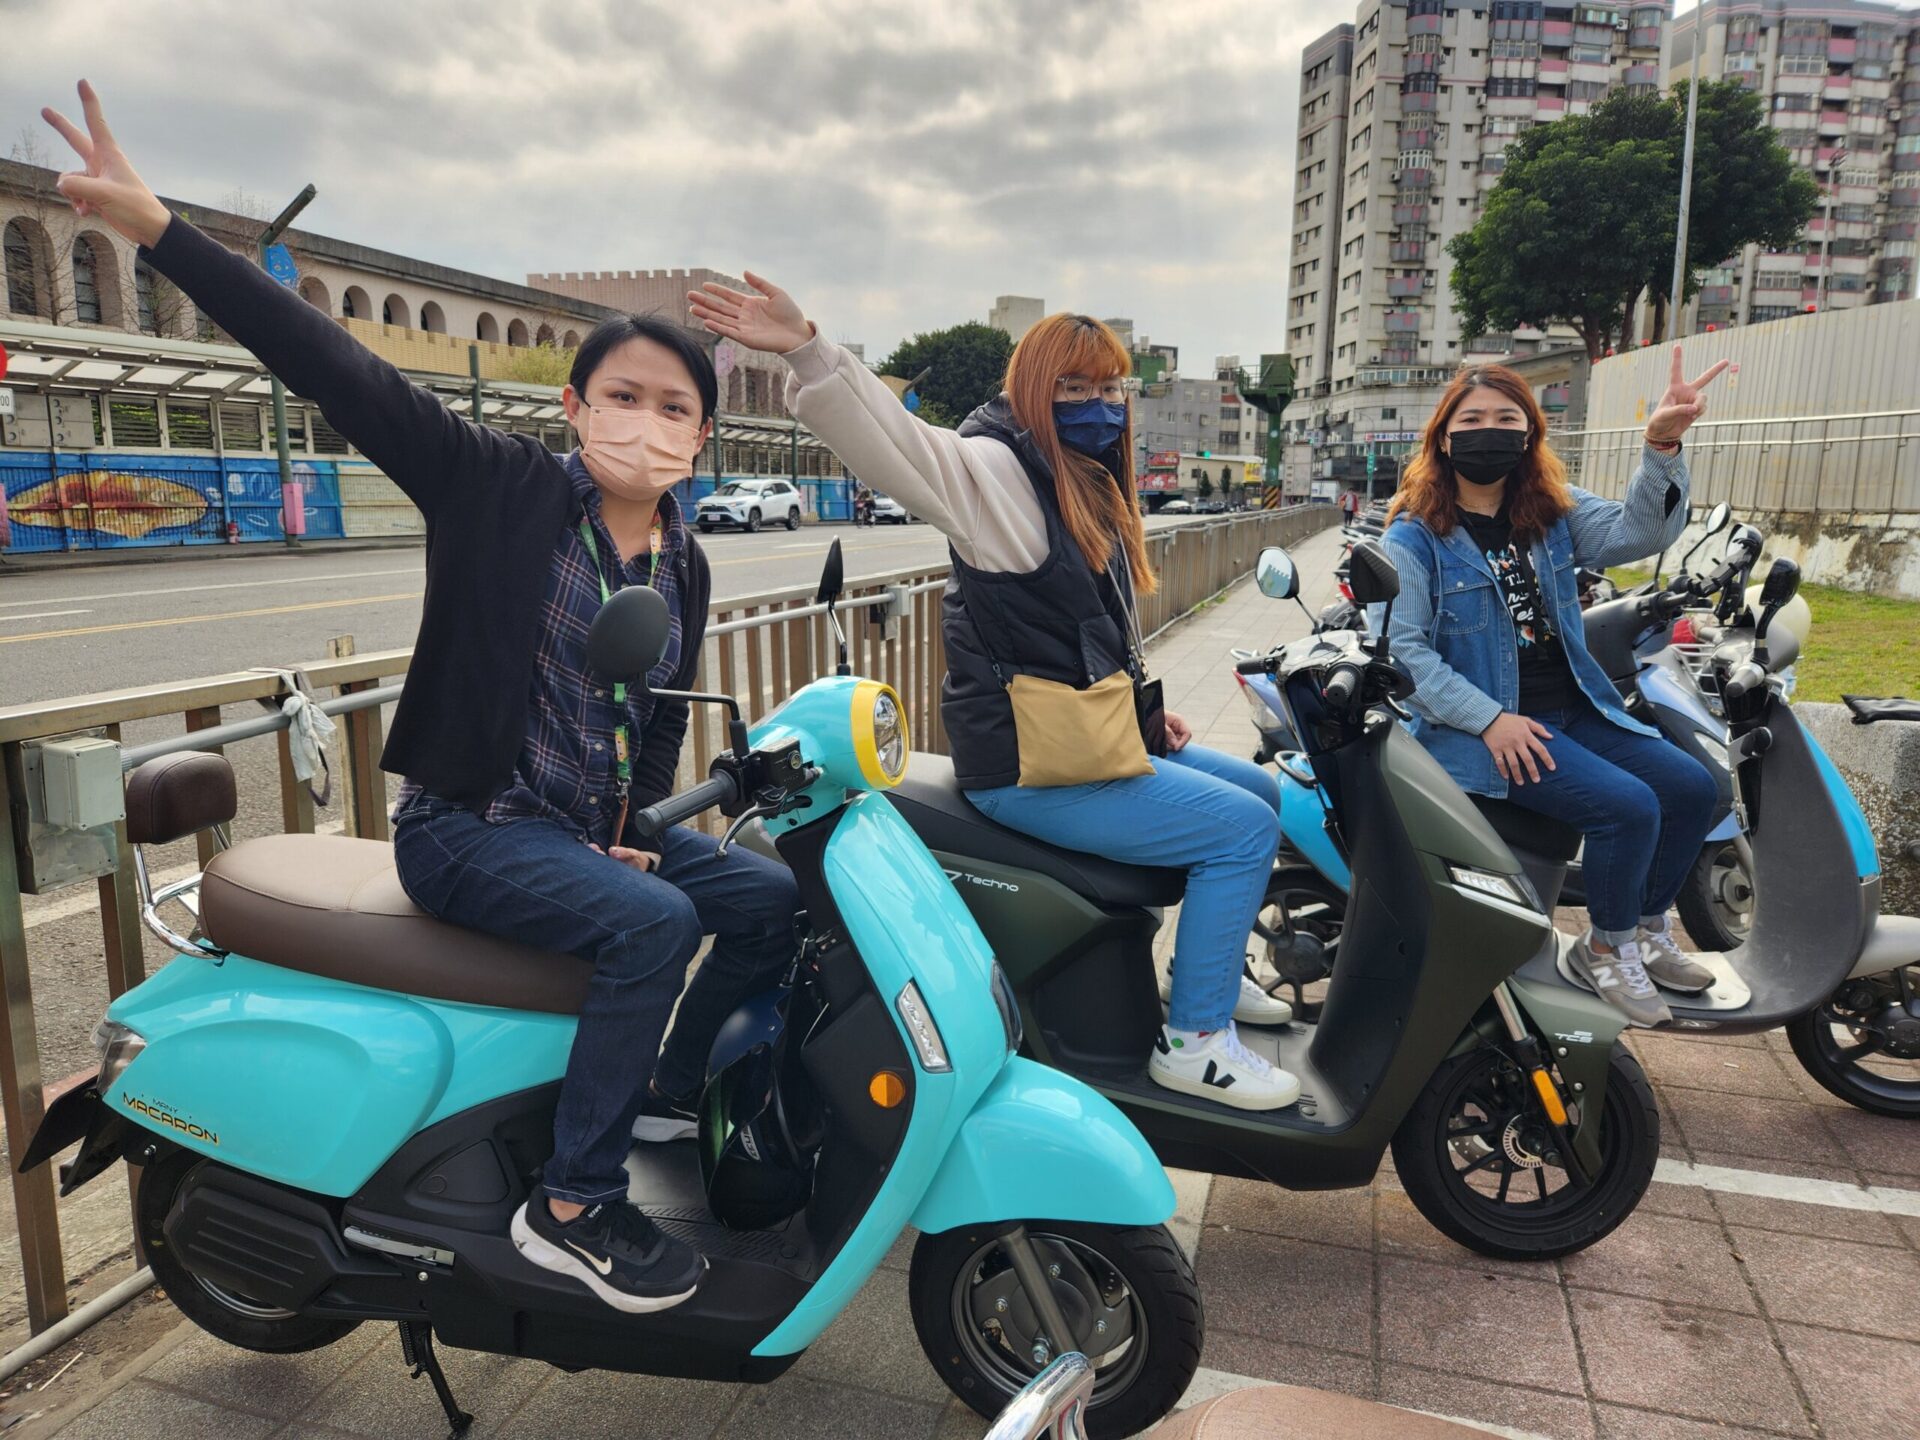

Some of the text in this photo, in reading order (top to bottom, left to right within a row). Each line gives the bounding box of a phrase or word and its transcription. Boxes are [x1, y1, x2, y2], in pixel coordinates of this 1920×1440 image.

[965, 873, 1019, 892] Techno
[1554, 1032, 1593, 1043] TCS
[152, 1097, 178, 1114] MANY
[123, 1091, 219, 1145] MACARON
